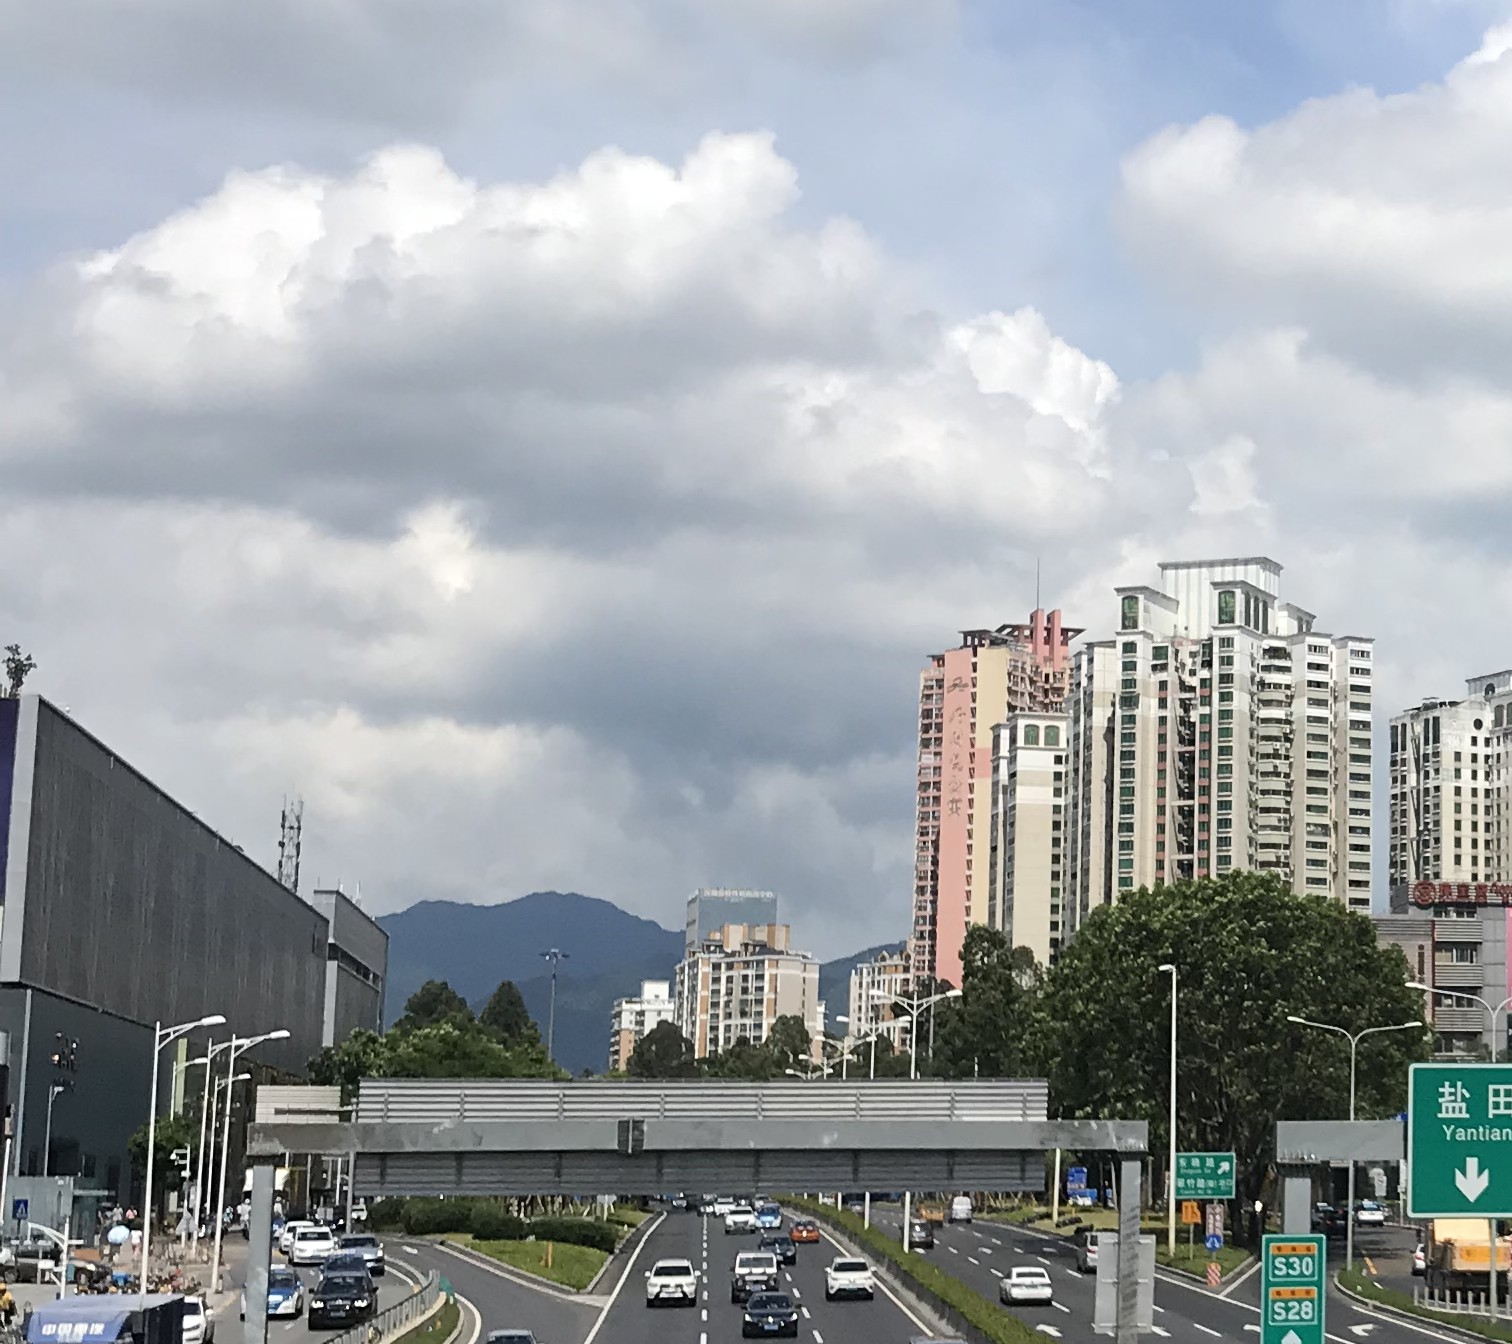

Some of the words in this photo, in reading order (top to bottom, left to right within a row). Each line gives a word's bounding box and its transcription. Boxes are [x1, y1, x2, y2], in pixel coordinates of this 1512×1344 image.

[1442, 1124, 1512, 1141] Yantian
[1273, 1256, 1313, 1276] S30
[1273, 1300, 1313, 1321] S28
